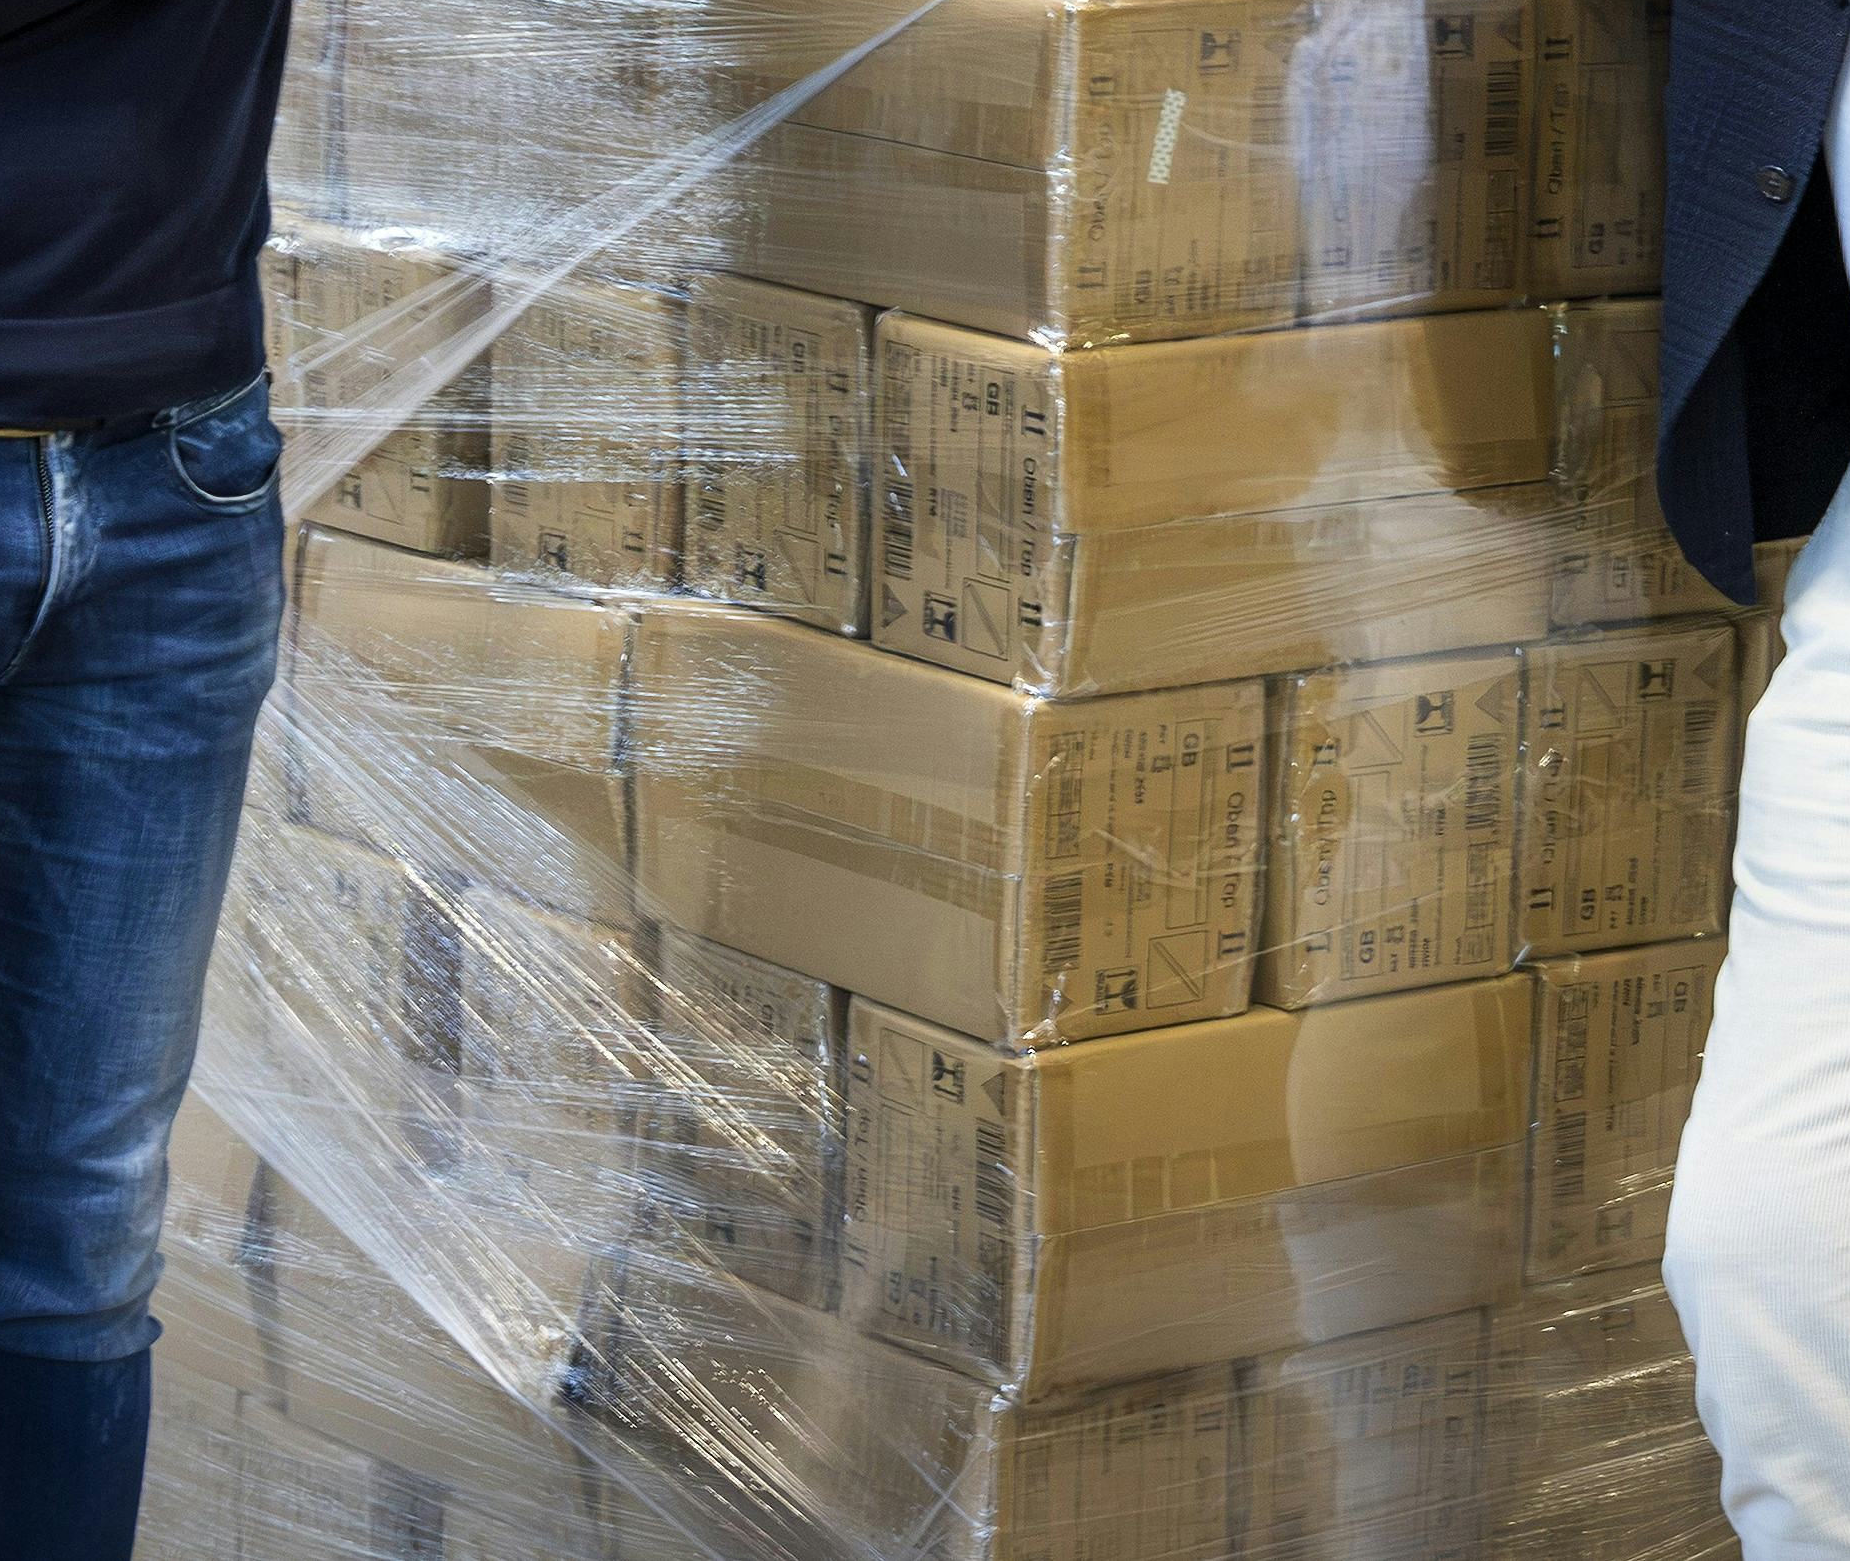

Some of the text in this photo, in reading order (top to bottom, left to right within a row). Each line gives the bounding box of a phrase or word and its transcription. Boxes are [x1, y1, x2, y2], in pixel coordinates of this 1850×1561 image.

[986, 382, 1001, 416] GB
[1021, 458, 1038, 515] Oben
[1019, 536, 1036, 578] Top
[1181, 733, 1199, 767] GB
[1224, 792, 1246, 849] Oben
[1221, 868, 1243, 908] Top
[1580, 888, 1596, 921] GB
[1360, 930, 1375, 964] GB
[854, 1107, 871, 1146] Top
